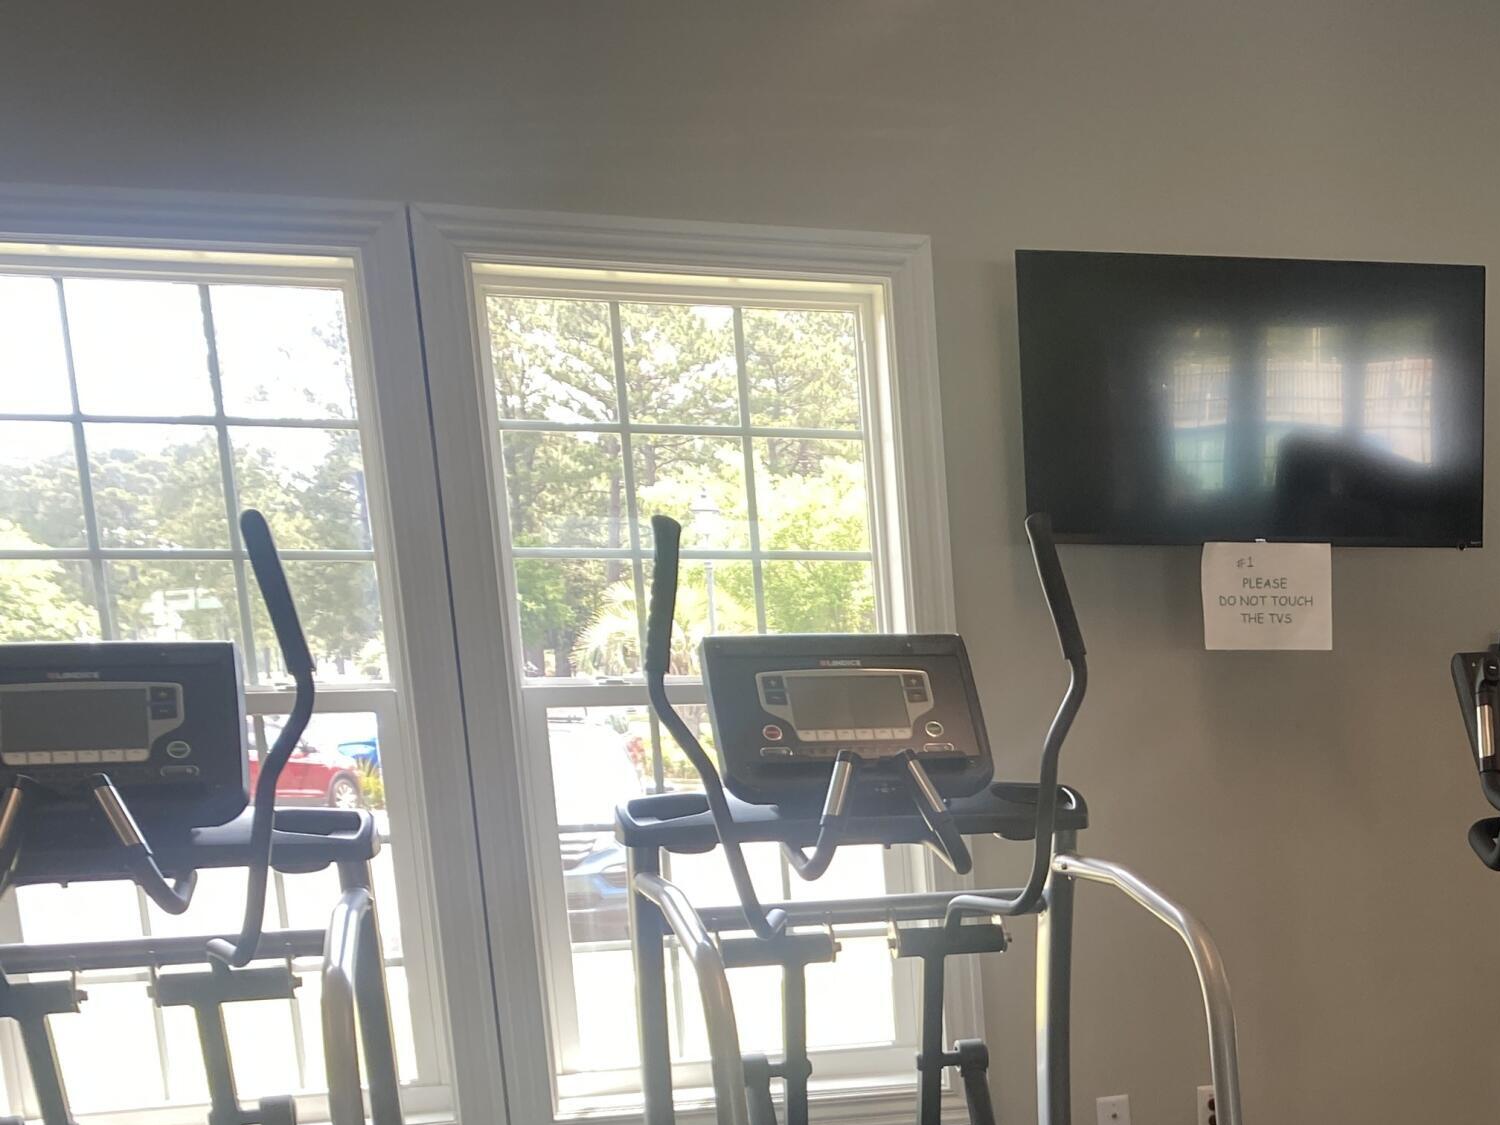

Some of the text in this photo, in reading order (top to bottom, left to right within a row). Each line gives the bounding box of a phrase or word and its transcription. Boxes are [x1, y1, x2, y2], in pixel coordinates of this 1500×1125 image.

[1242, 577, 1288, 589] PLEASE
[1219, 595, 1314, 607] DO NOT TOUCH
[1240, 613, 1292, 624] THE TVS
